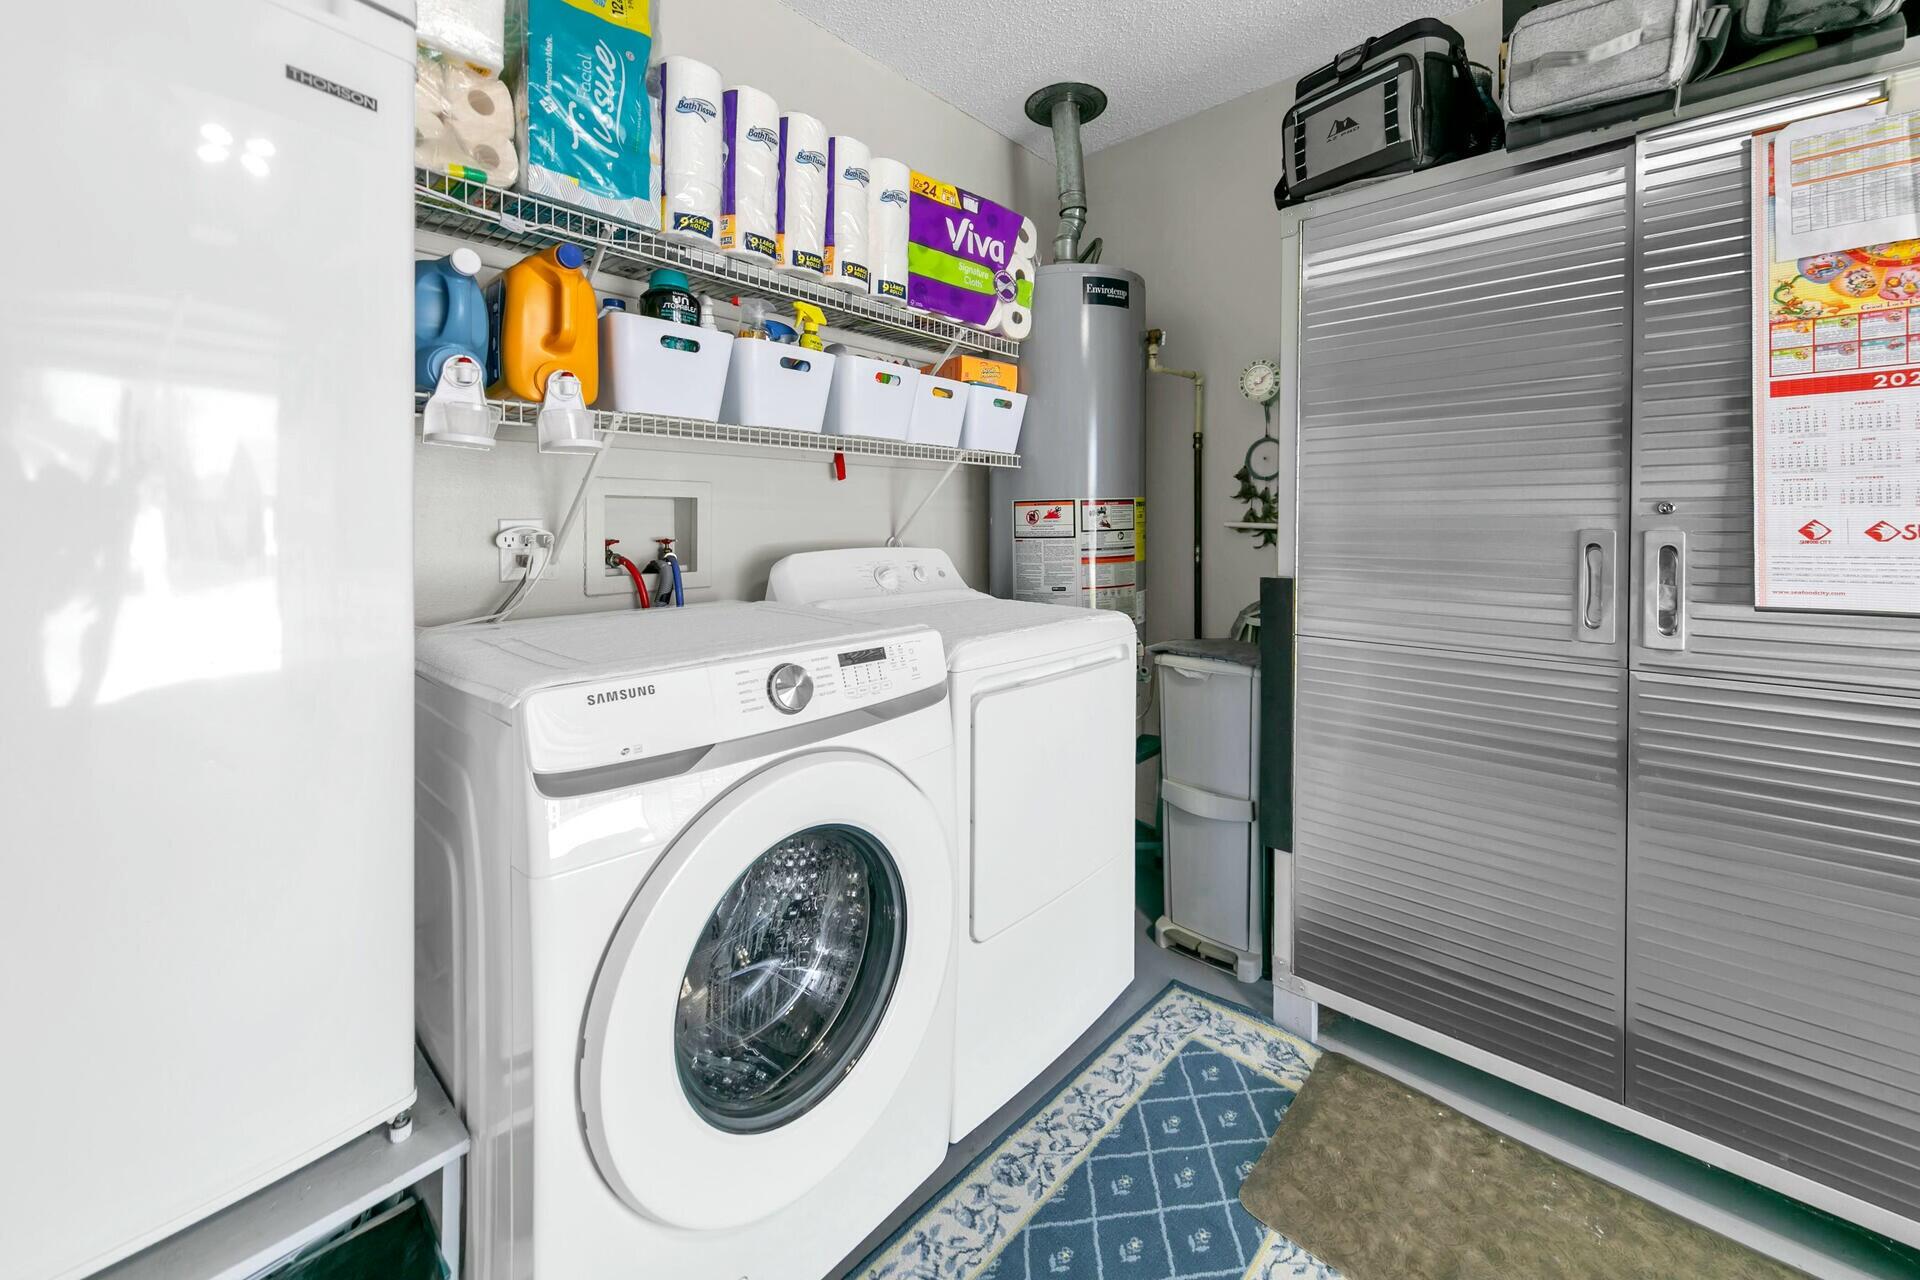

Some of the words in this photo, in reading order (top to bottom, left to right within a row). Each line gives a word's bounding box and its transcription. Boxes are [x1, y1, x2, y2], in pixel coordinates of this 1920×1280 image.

[576, 53, 593, 98] Facial
[288, 67, 376, 111] THOMSON
[568, 39, 620, 159] Tissue
[945, 216, 1005, 265] Viva
[797, 254, 806, 264] 9
[846, 264, 854, 274] 9
[958, 262, 990, 279] Signature
[882, 282, 890, 291] 9
[964, 275, 984, 289] Cloth
[587, 684, 656, 706] SAMSUNG
